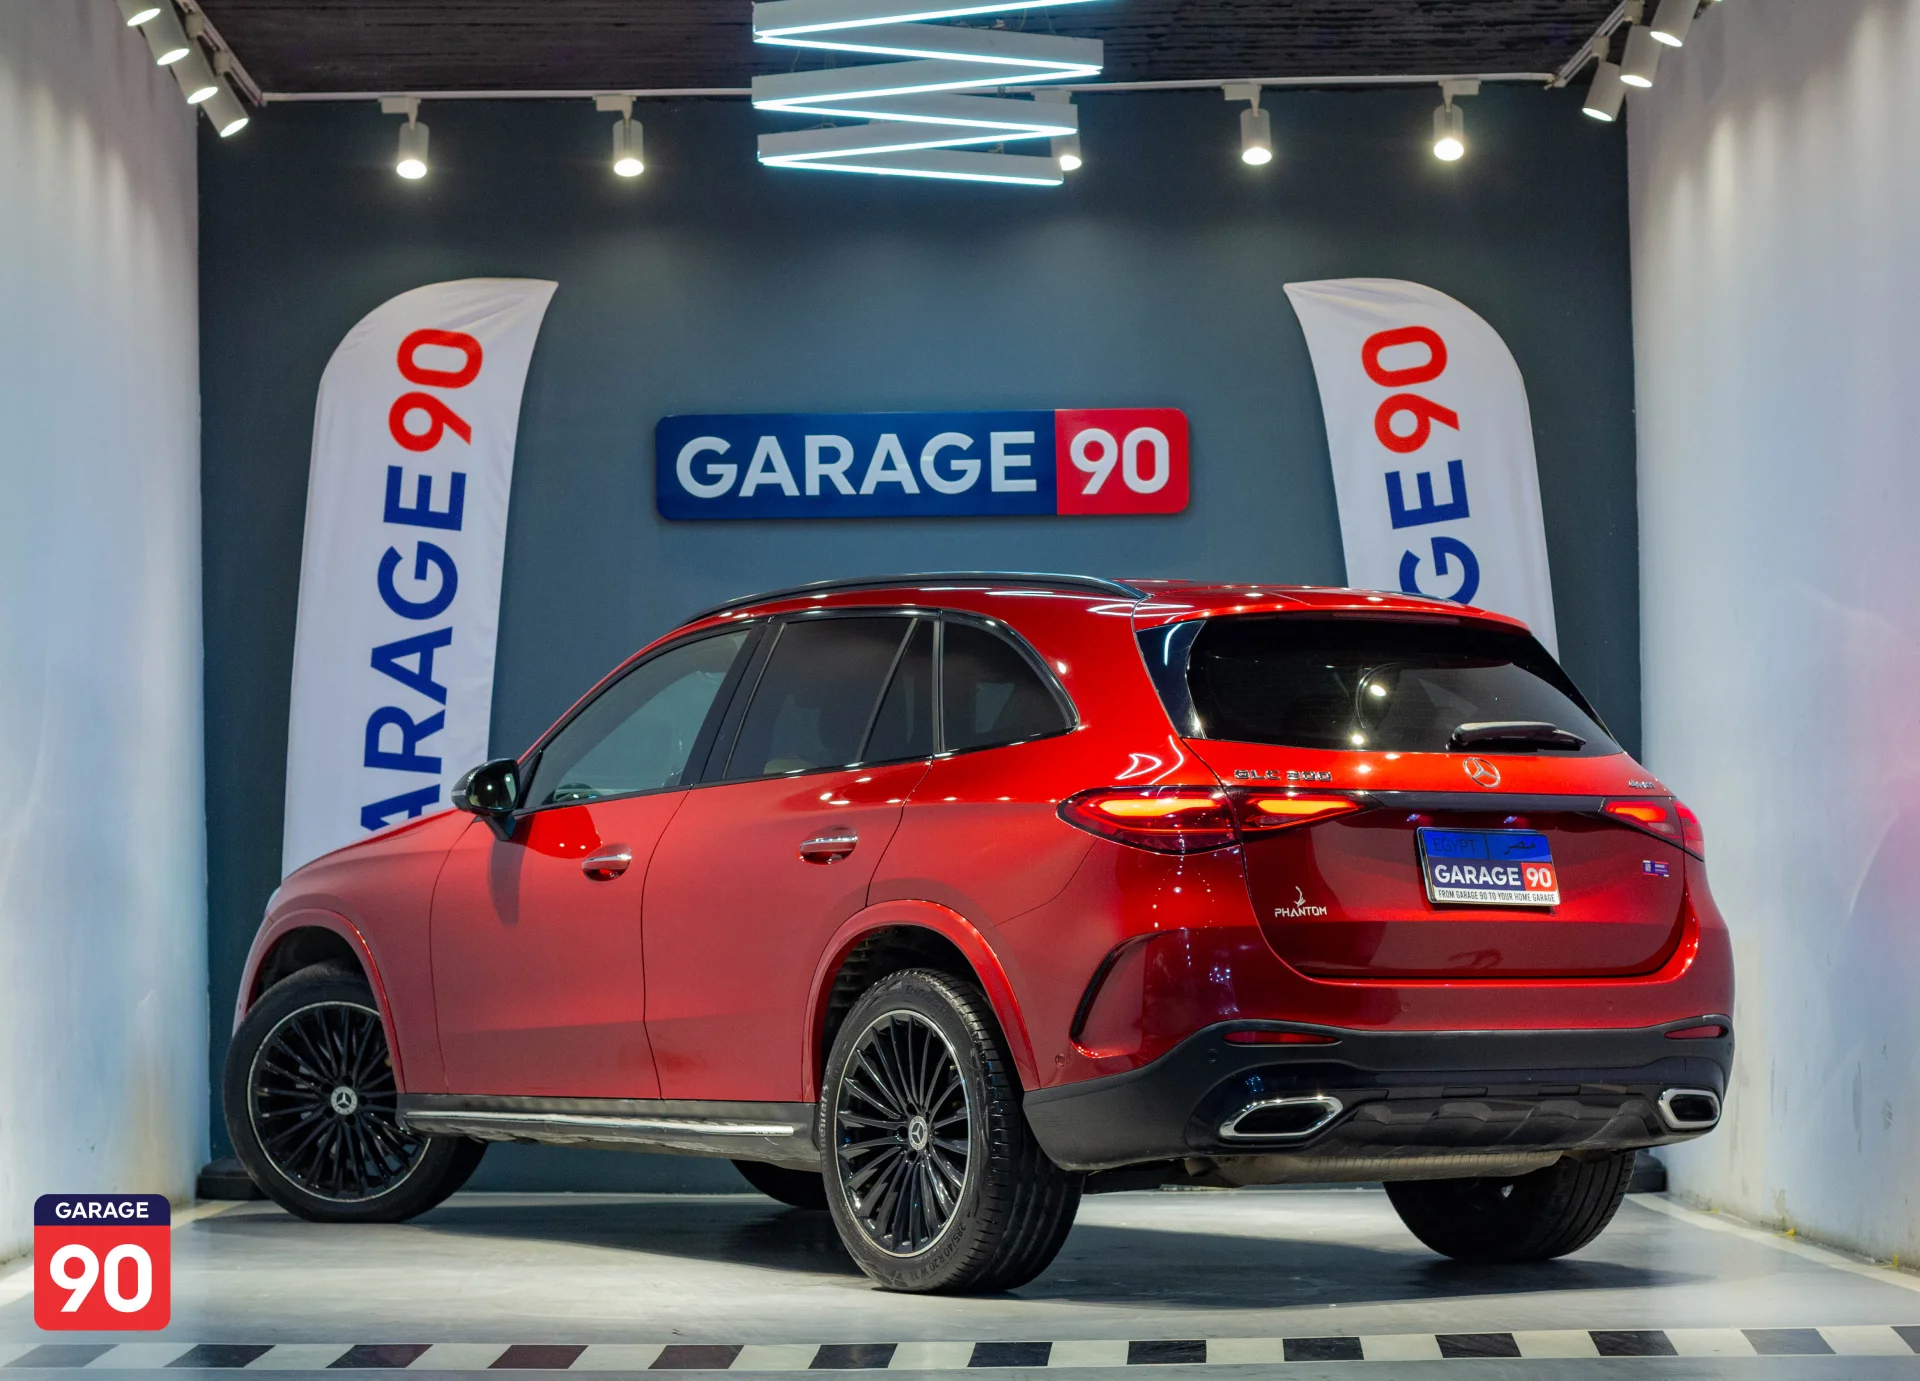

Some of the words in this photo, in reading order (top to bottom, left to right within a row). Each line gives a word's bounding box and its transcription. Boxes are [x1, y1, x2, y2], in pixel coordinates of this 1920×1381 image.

[676, 431, 1037, 498] GARAGE
[1069, 427, 1169, 495] 90
[1234, 769, 1280, 780] GLC
[1432, 837, 1477, 853] EGYPT
[1503, 840, 1536, 855] مصر
[1434, 864, 1521, 886] GARAGE
[1526, 867, 1552, 888] 90
[1438, 889, 1455, 898] FROM
[1456, 890, 1478, 900] GARAGE
[1479, 891, 1488, 900] 90
[1489, 892, 1497, 900] TO
[1498, 892, 1513, 901] YOUR
[1514, 893, 1531, 902] HOME
[1532, 893, 1556, 903] GARAGE
[1274, 906, 1327, 917] PHANTOM
